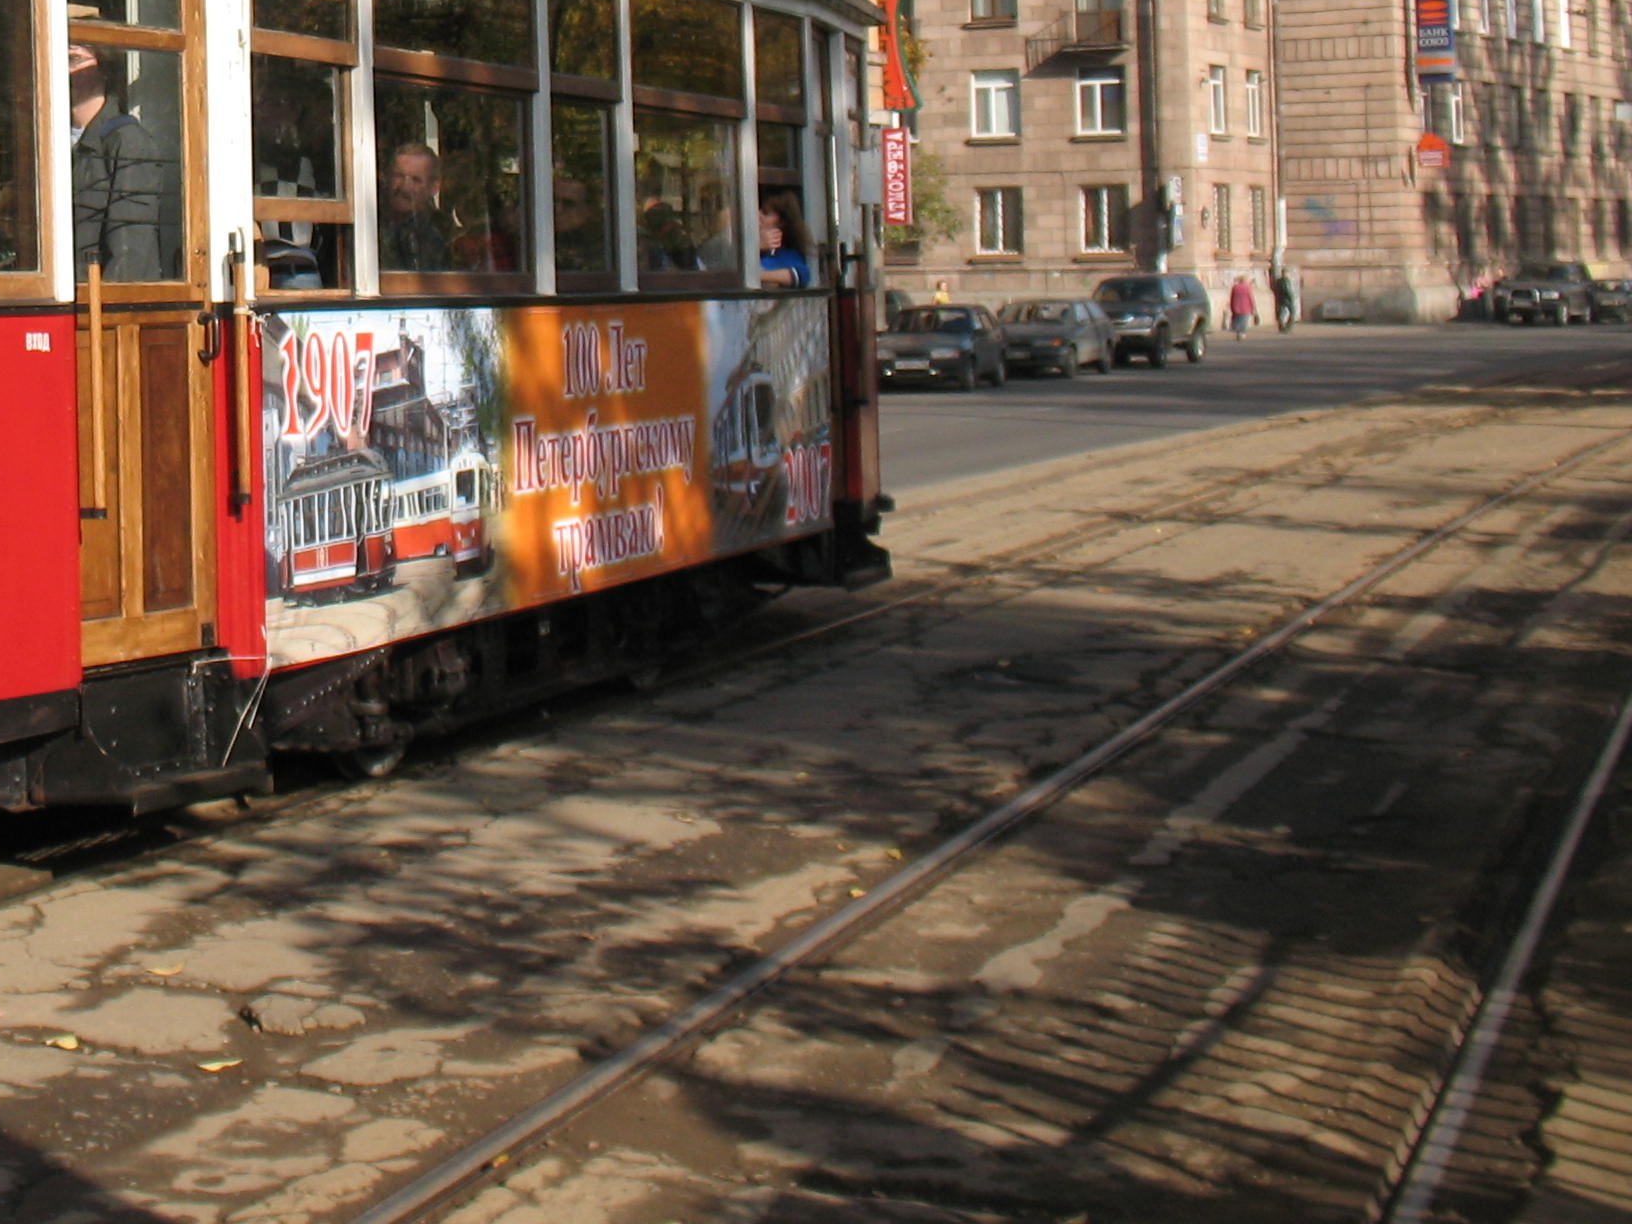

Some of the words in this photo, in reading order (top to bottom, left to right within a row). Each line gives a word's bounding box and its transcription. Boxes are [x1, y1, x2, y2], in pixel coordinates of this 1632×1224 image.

[1419, 27, 1448, 37] БАНК
[26, 332, 51, 353] ВХОД
[279, 329, 376, 438] 1907
[563, 324, 601, 397] 100
[606, 322, 648, 393] Лет
[513, 408, 697, 505] Петербургскому
[783, 443, 832, 525] 2007
[554, 483, 665, 593] трамваю!
